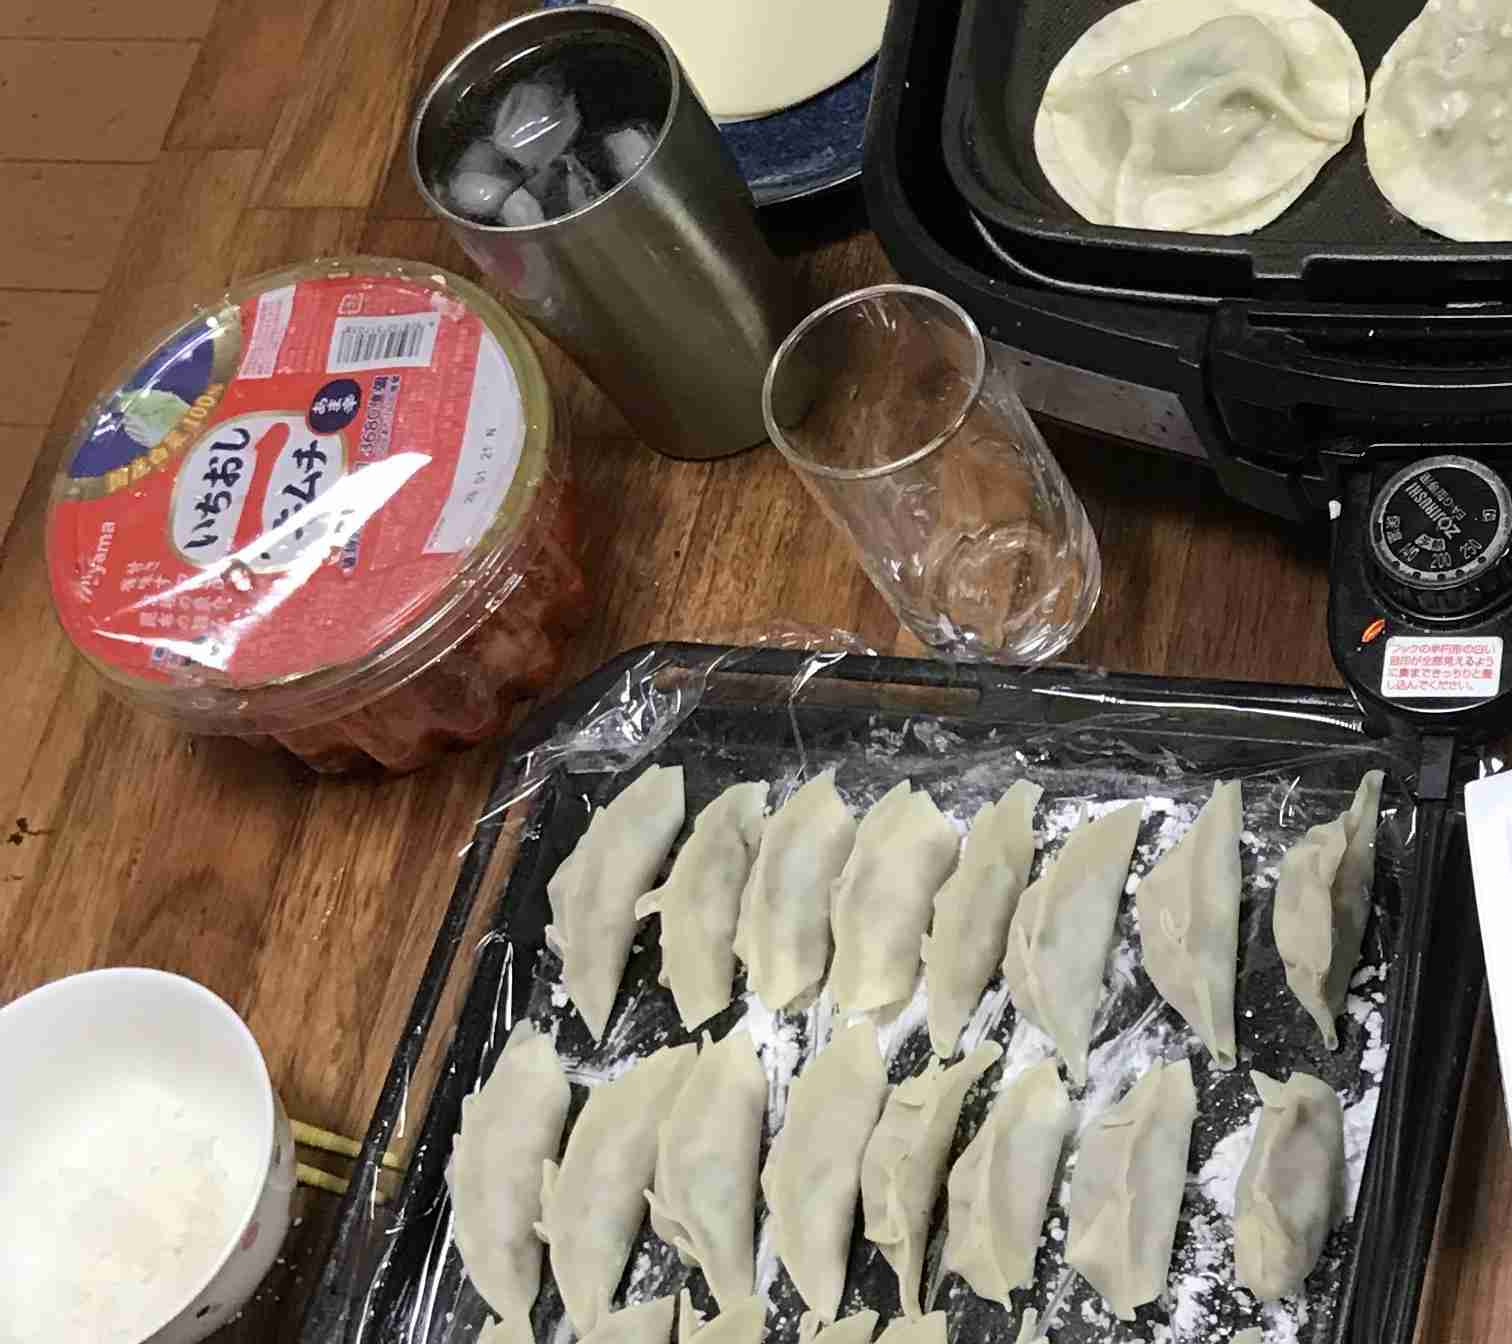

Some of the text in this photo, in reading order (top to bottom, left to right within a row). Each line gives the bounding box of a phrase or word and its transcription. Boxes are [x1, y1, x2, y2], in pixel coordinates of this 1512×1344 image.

[184, 427, 251, 550] いちおし
[1405, 482, 1462, 540] ZOJIRUSHI
